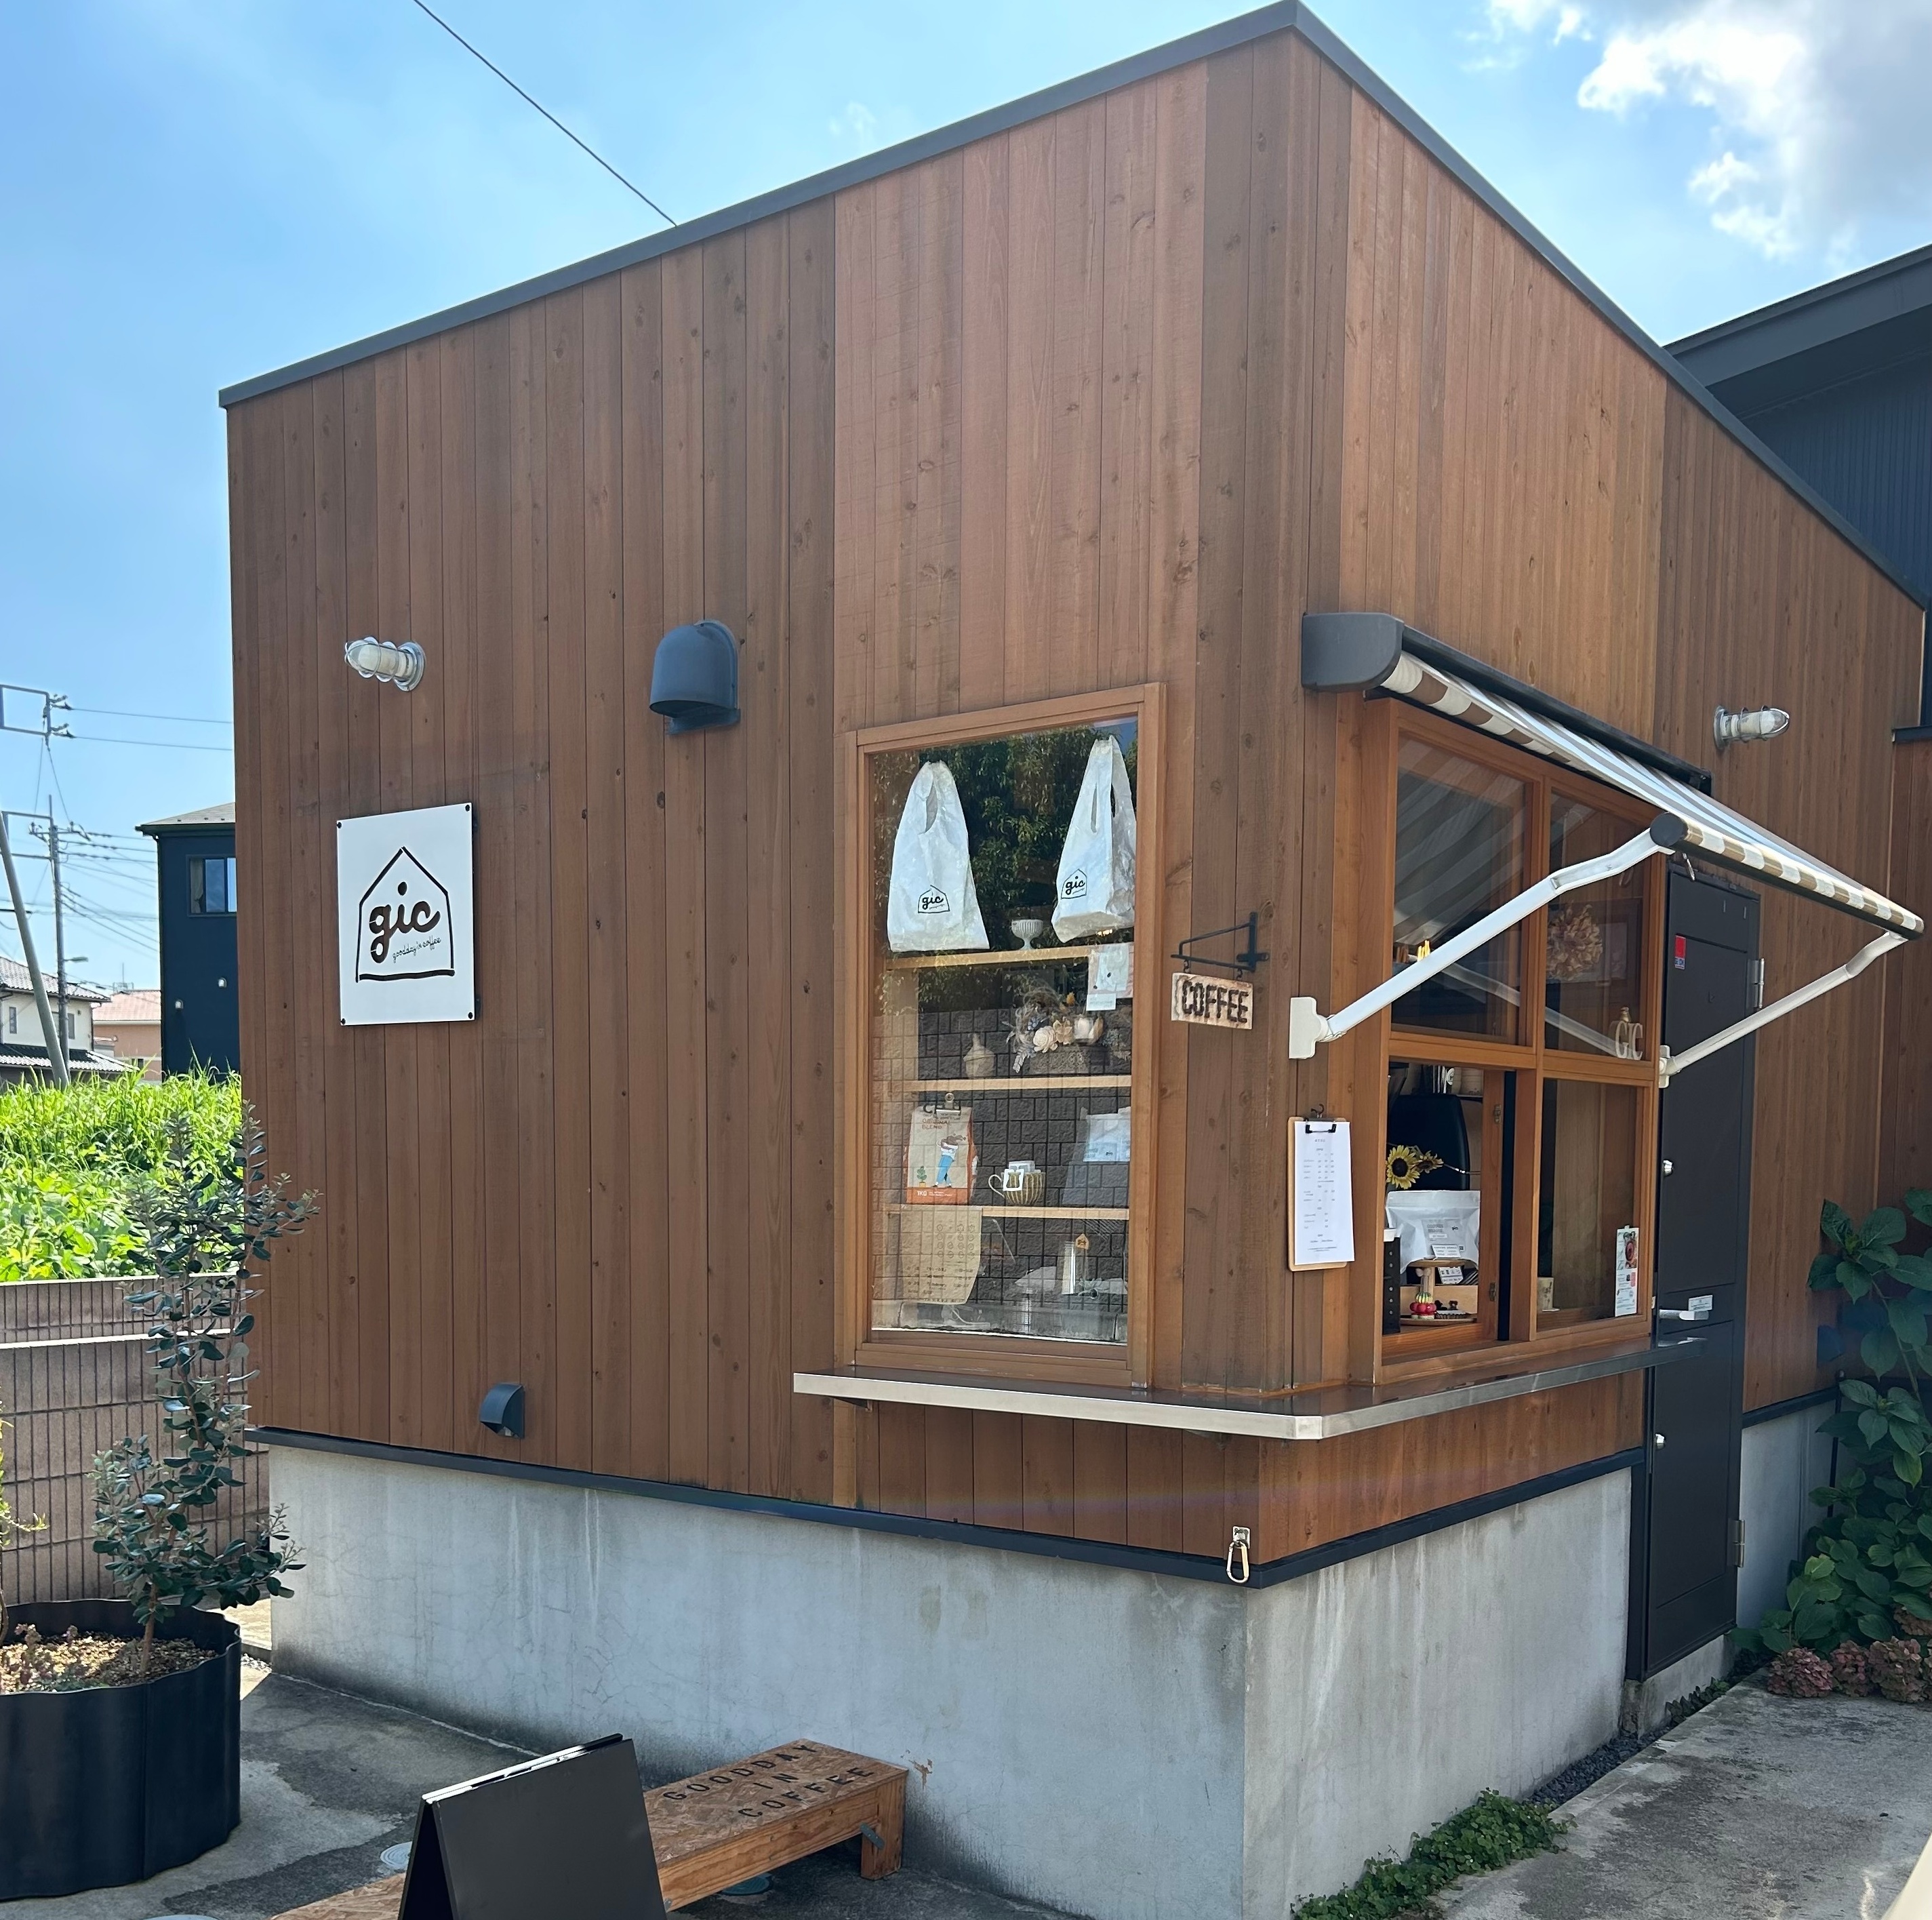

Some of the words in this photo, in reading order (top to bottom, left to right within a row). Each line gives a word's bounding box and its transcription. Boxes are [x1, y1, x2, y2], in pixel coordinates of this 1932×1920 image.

[922, 892, 944, 910] gic
[1065, 876, 1086, 896] gic
[369, 881, 441, 963] gic
[1182, 980, 1249, 1023] COFFEE
[663, 1744, 817, 1800] GOODDAY
[738, 1767, 874, 1818] COFFEE
[753, 1773, 799, 1790] IN
